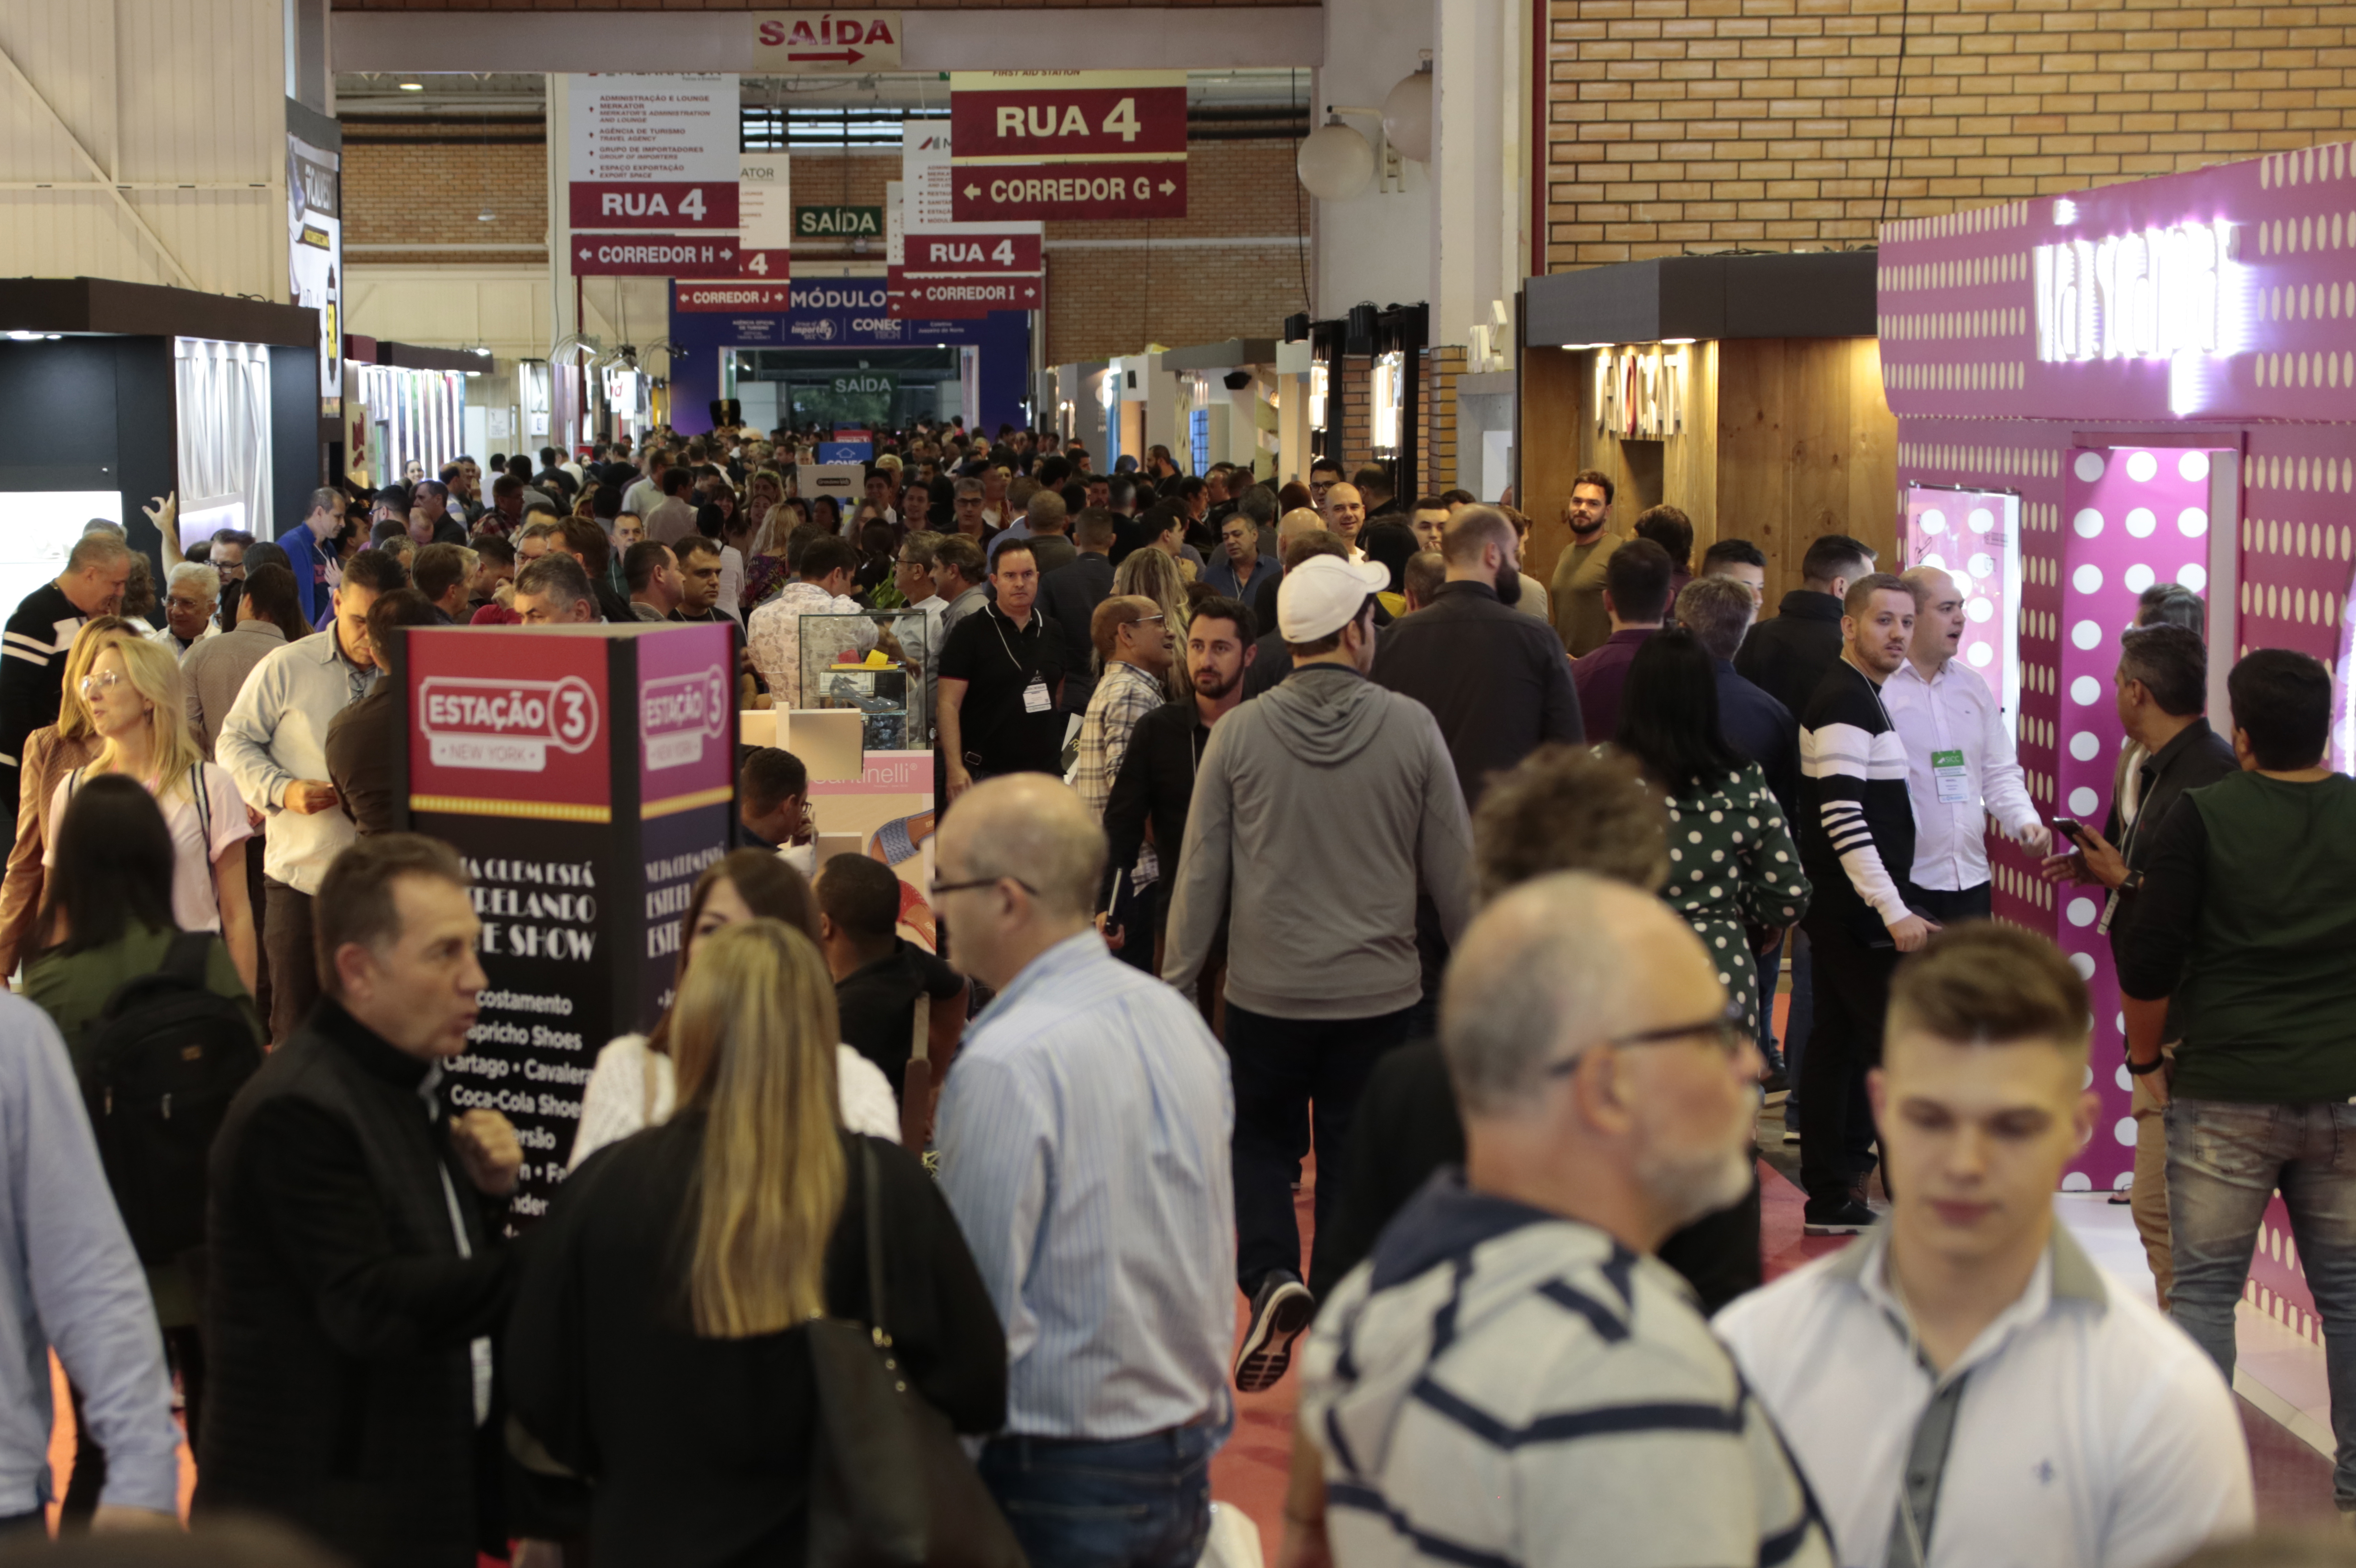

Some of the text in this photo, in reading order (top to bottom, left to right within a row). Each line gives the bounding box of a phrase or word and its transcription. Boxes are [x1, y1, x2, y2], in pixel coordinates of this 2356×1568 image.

[759, 14, 894, 46] SAÍDA
[996, 98, 1142, 142] RUA 4
[741, 168, 774, 178] ATOR
[990, 177, 1151, 204] CORREDOR G
[601, 188, 707, 221] RUA 4
[802, 212, 877, 233] SAÍDA
[598, 246, 714, 264] CORREDOR H
[749, 253, 768, 275] 4
[930, 239, 1015, 266] RUA 4
[693, 291, 770, 305] CORREDOR J
[790, 288, 886, 308] MÓDULO
[926, 286, 1015, 301] CORREDOR I
[852, 318, 901, 331] CONEC
[835, 375, 893, 394] SAÍDA
[430, 691, 586, 738] ESTAÇÃO 3
[709, 679, 721, 724] 3
[450, 744, 483, 760] NEW
[813, 763, 908, 784] inelli
[464, 886, 597, 924] RELANDO
[508, 924, 597, 962] SHOW
[475, 989, 573, 1016] costamento
[465, 1020, 583, 1051] apricho Shoes
[442, 1053, 509, 1080] Cartago
[450, 1084, 582, 1119] Coca-Cola Shoe
